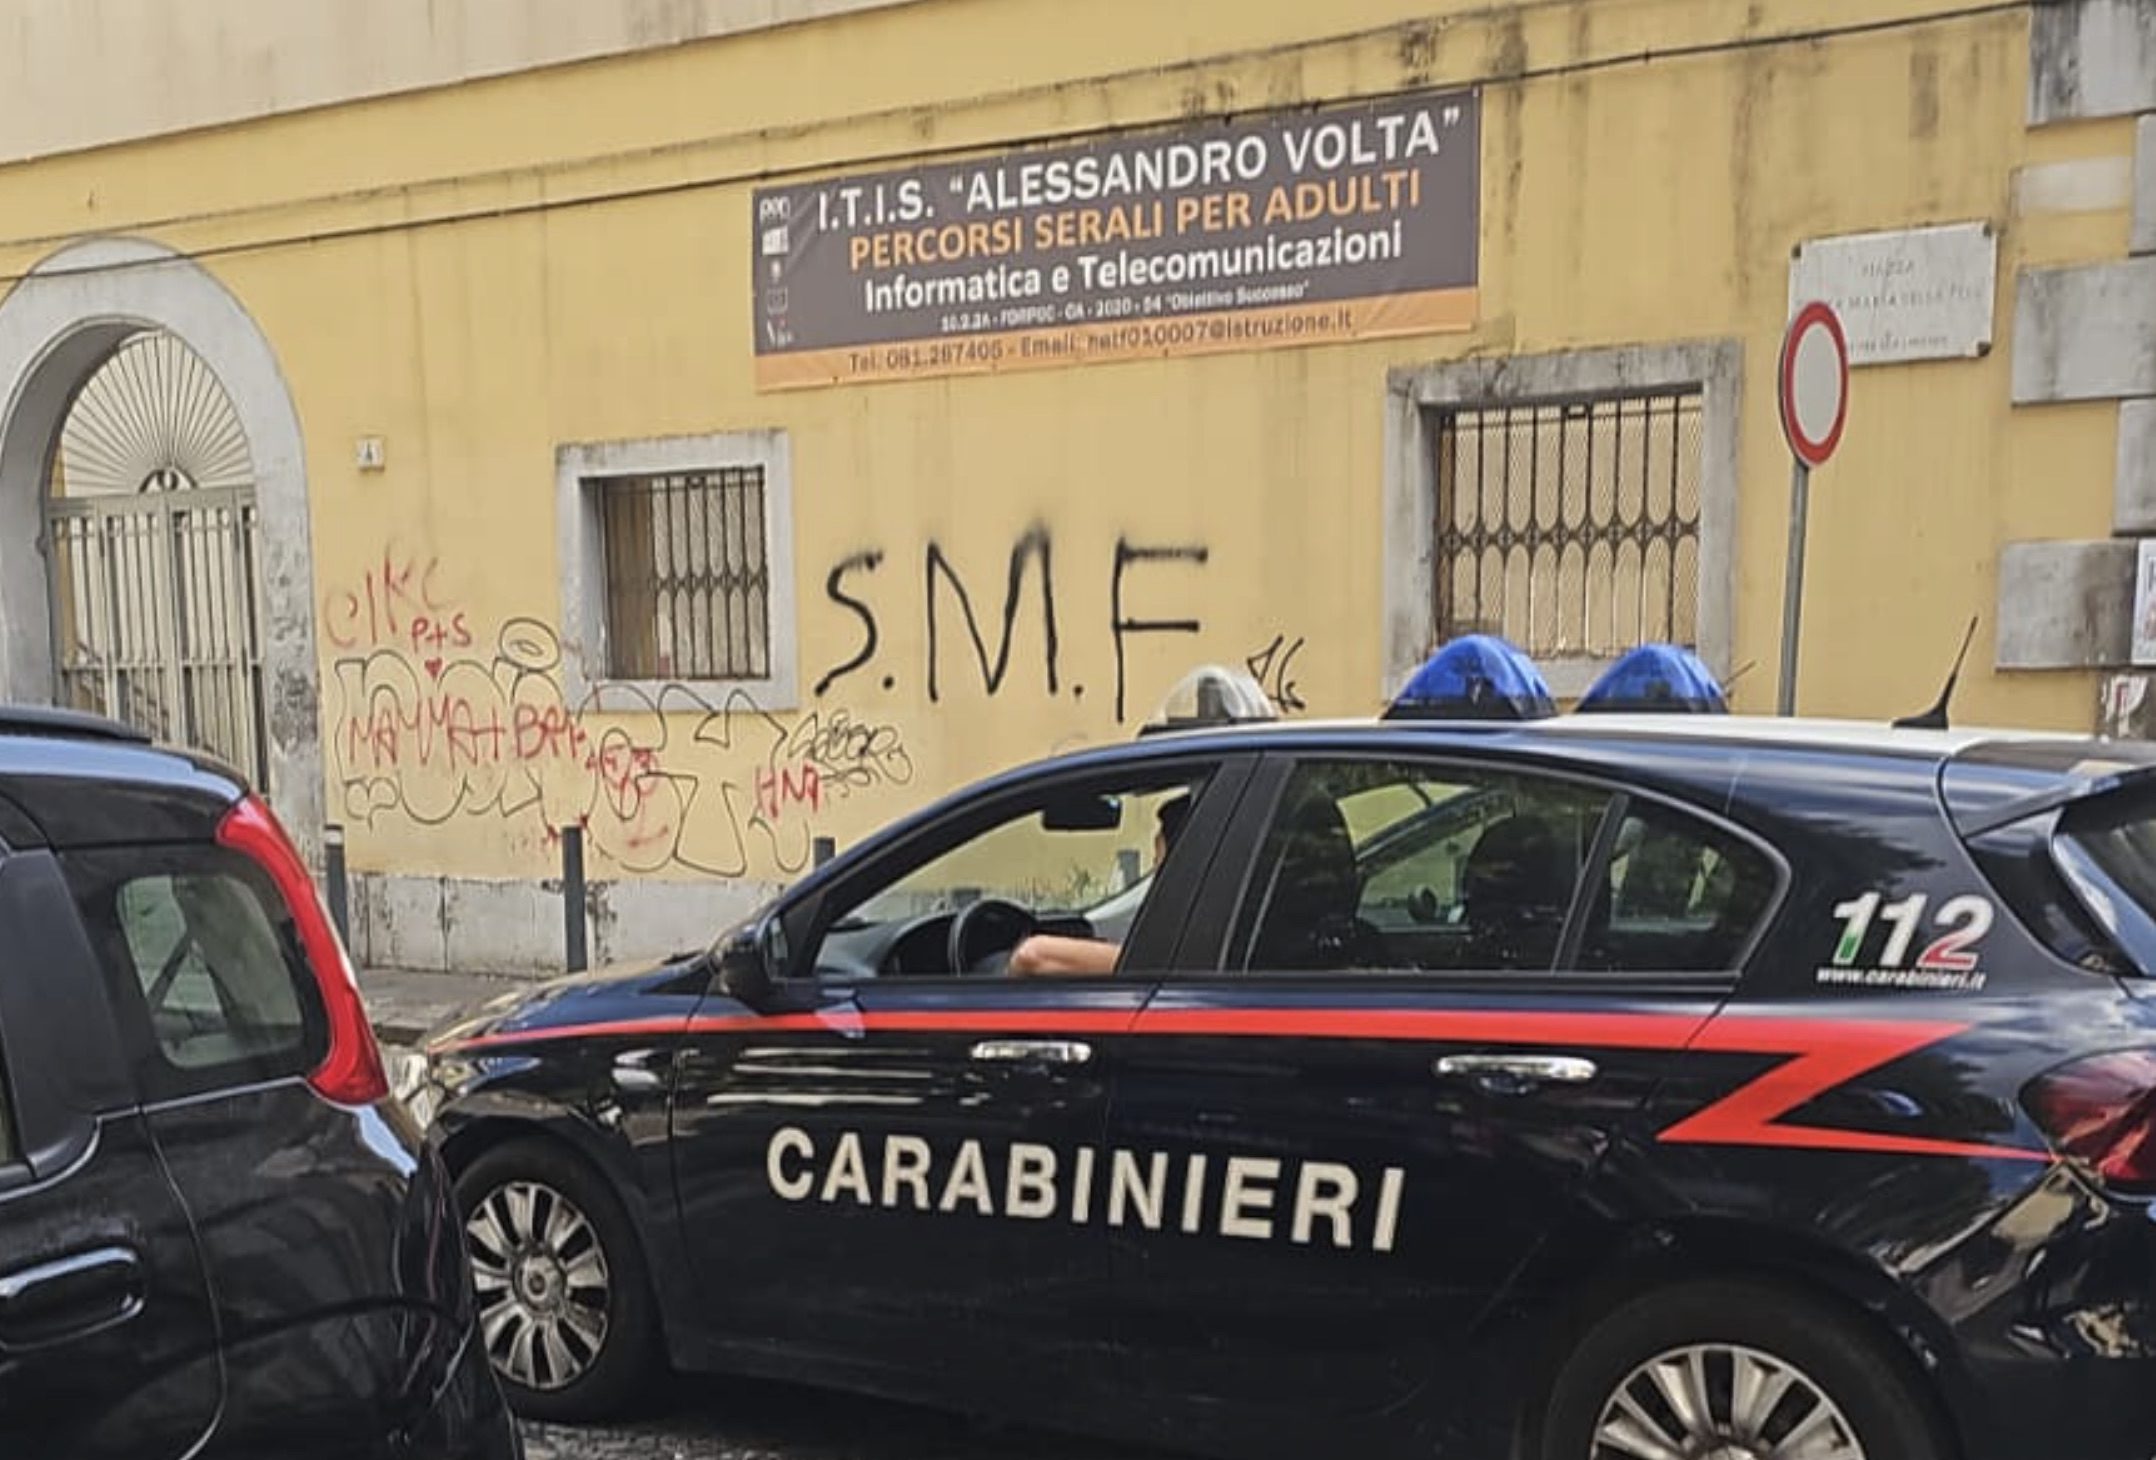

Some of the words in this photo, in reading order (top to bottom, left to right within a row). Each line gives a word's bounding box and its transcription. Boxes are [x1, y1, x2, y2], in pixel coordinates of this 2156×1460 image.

[818, 179, 934, 231] I.T.I.S.
[851, 216, 1022, 270] PERCORSI
[1035, 201, 1163, 249] SERALI
[1177, 192, 1251, 234] PER
[1264, 169, 1421, 225] ADULTI
[866, 263, 1041, 312] Informatica
[1052, 265, 1069, 293] e
[1078, 220, 1402, 290] Telecomunicazioni
[1833, 891, 1994, 970] 112
[1816, 967, 1987, 991] www.carabinieri.it
[766, 1126, 1404, 1253] CARABINIERI
